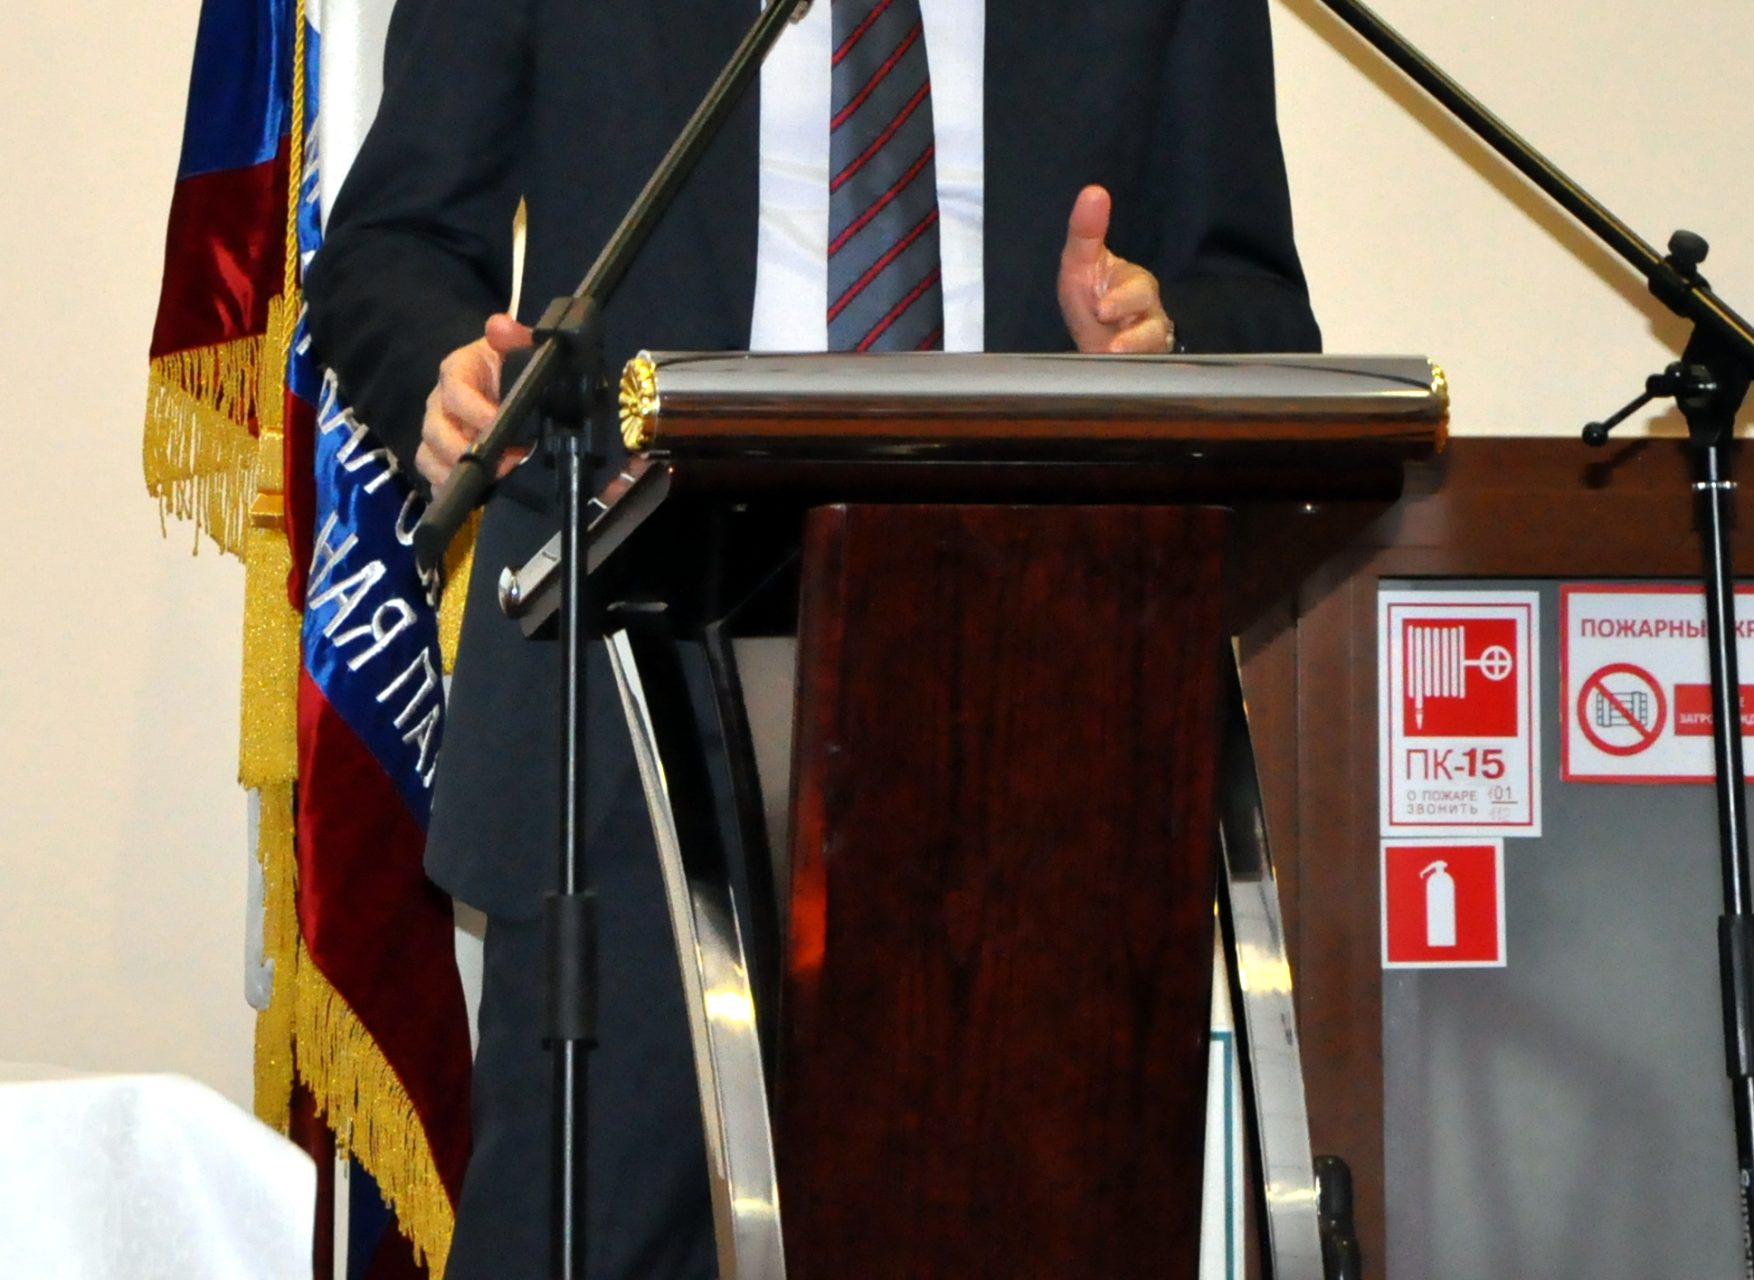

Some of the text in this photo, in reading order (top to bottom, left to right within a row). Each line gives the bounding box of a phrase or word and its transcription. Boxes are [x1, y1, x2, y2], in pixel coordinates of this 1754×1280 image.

[1581, 618, 1708, 638] ПОЖАРНЫ
[1405, 748, 1506, 780] ПК-15
[1406, 789, 1479, 802] О ПОЖАРЕ
[1406, 803, 1479, 816] ЗВОНИТЬ
